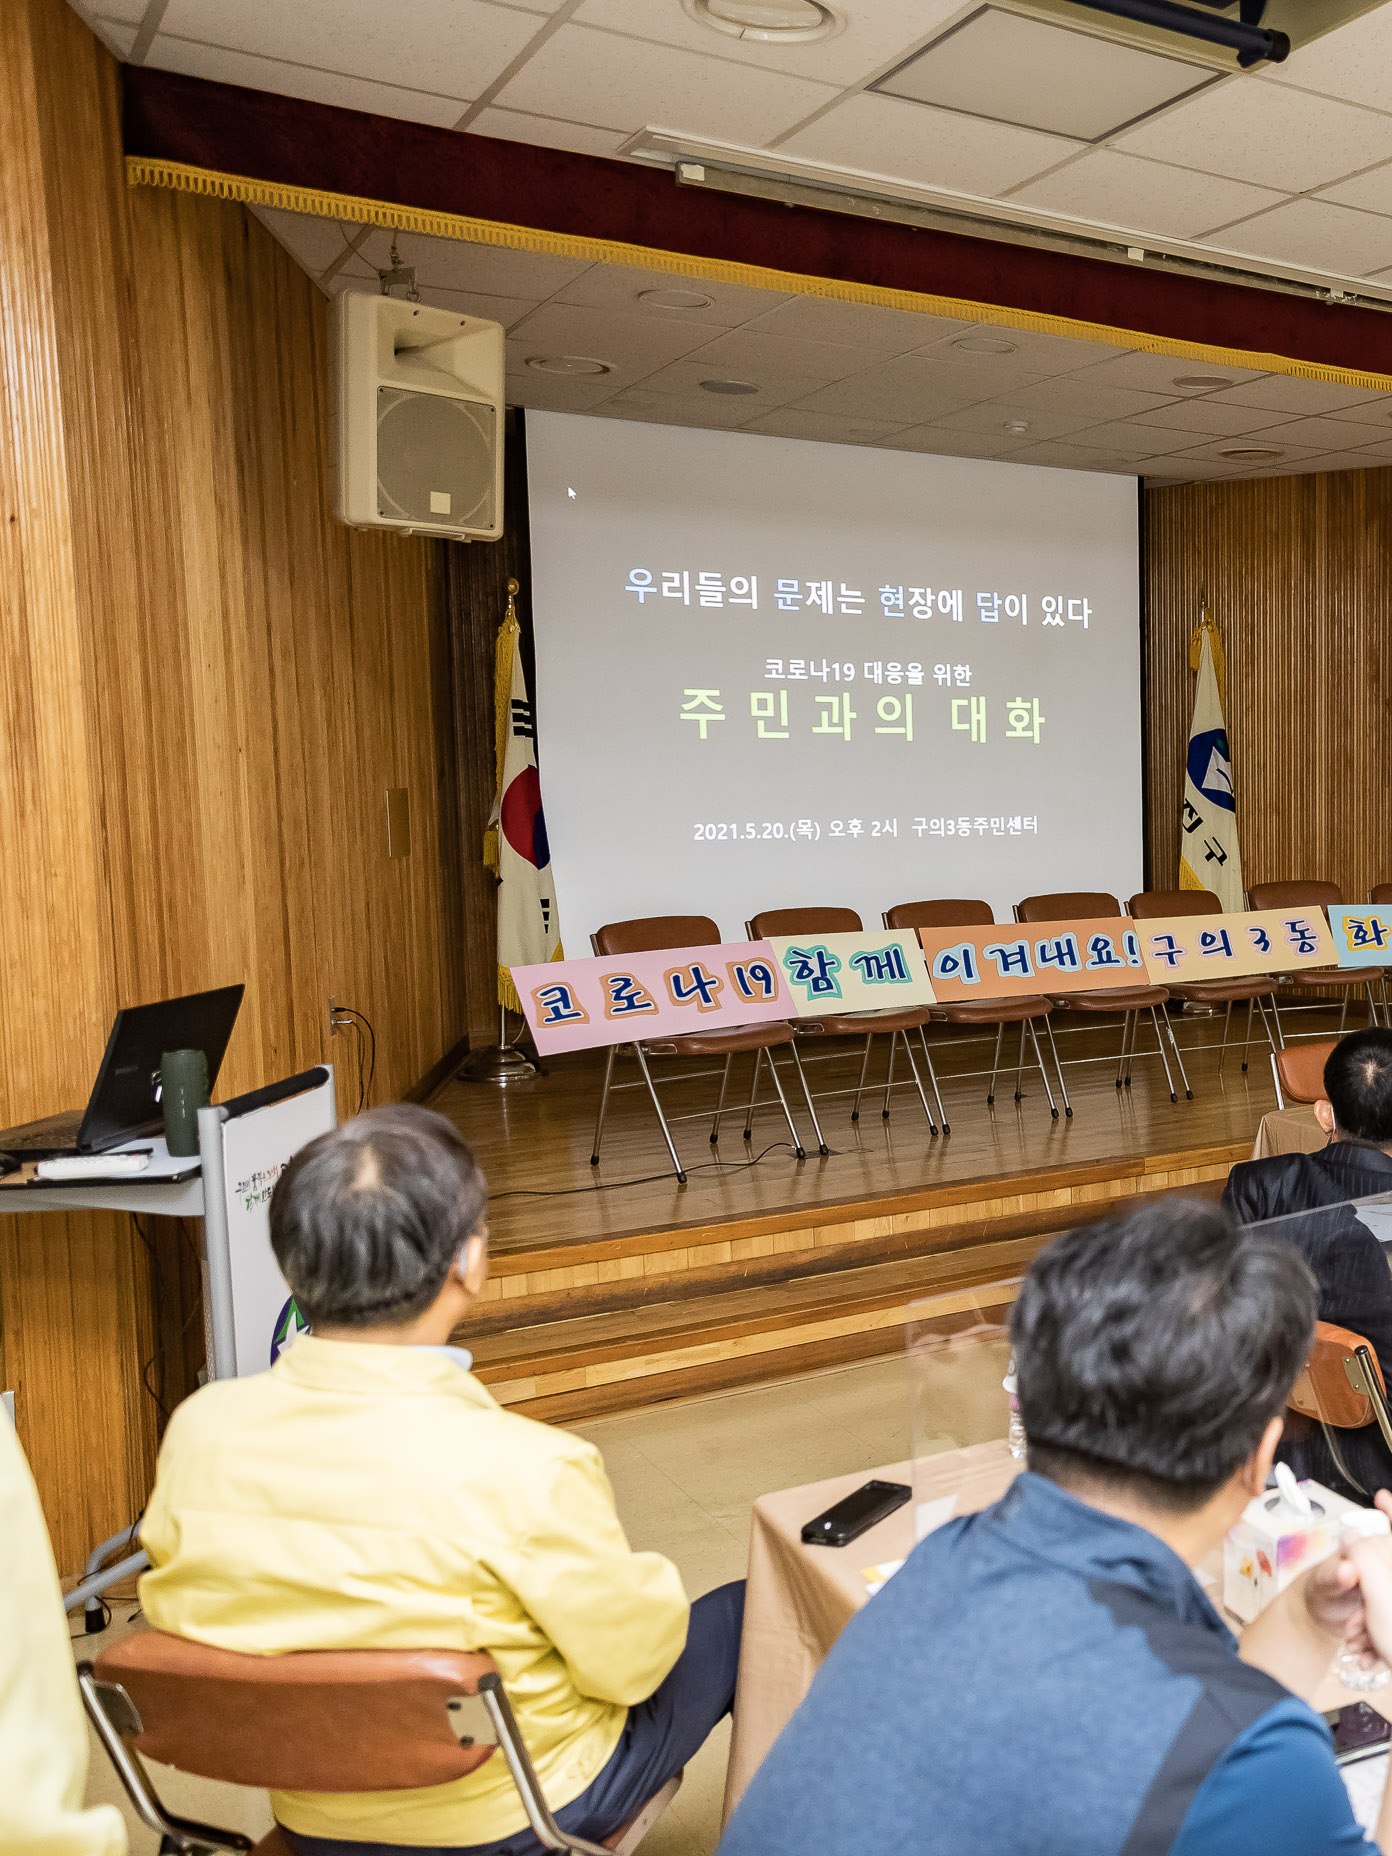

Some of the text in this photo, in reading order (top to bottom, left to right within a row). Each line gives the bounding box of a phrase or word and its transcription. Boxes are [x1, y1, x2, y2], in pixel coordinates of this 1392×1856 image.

[625, 569, 1092, 628] 우리들의 문제는 현장에 답이 있다
[764, 659, 972, 687] 코로나19 대응을 위한
[694, 816, 1037, 841] 2021.5.20.(목) 오후 2시 구의3동주민센터
[538, 960, 772, 1023] 코로나19
[789, 948, 907, 992] 함께
[940, 934, 1141, 980] 이겨내요!
[1153, 920, 1318, 966] 구의3동
